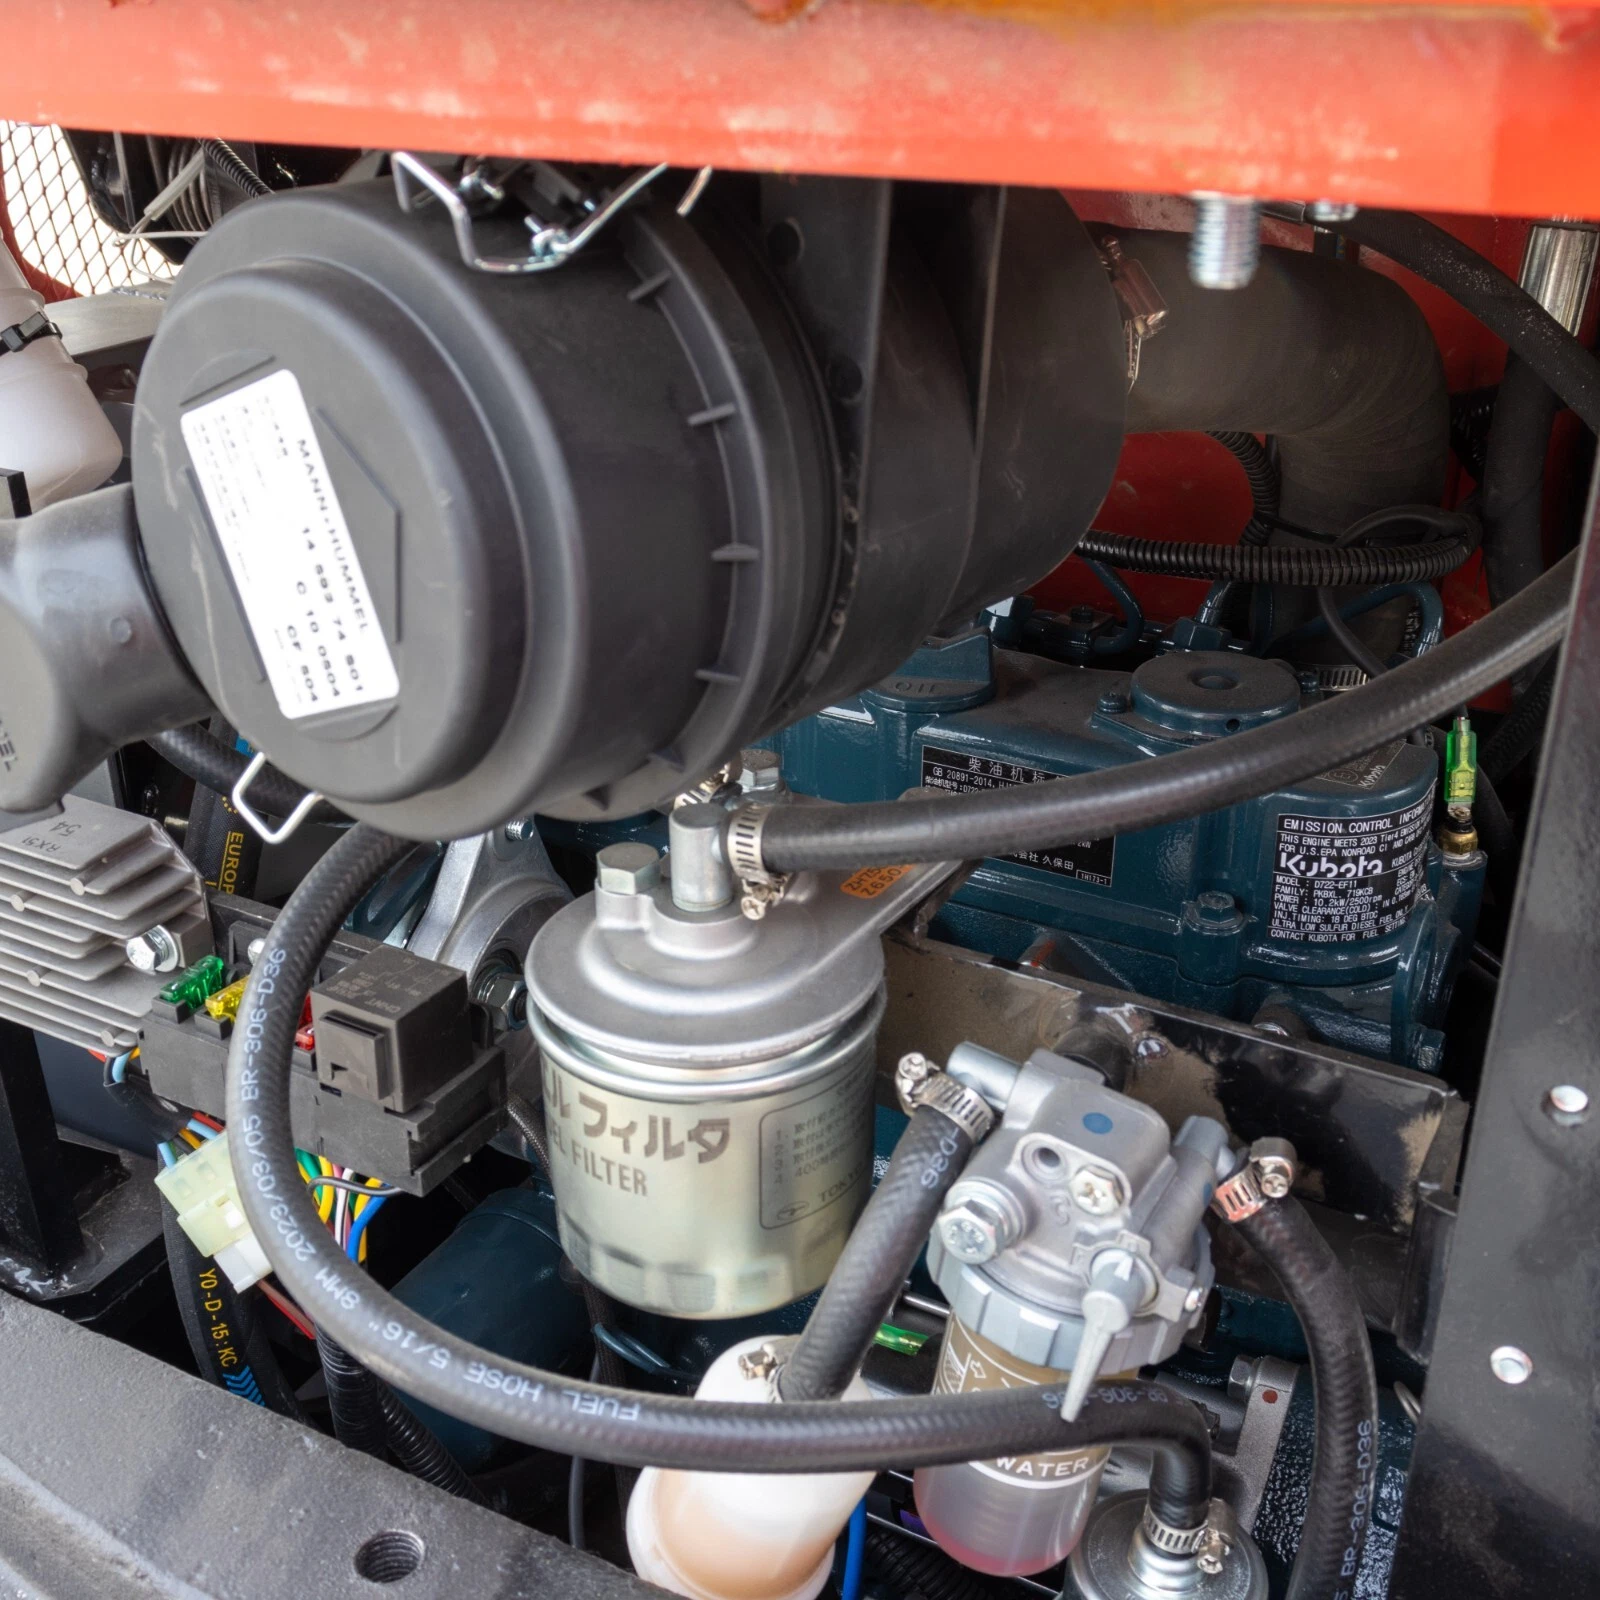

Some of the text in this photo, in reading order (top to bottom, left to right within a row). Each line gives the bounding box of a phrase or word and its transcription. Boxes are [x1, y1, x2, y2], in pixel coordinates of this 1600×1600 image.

[932, 766, 943, 777] GB
[1284, 818, 1343, 834] EMISSION
[1349, 817, 1393, 834] CONTROL
[1279, 842, 1296, 854] FOR
[1299, 846, 1338, 857] U.S.EPA
[1341, 845, 1376, 857] NONROAD
[1379, 843, 1388, 853] CI
[1392, 838, 1404, 850] AND
[1280, 833, 1299, 844] THIS
[1302, 836, 1331, 847] ENGINE
[1334, 838, 1358, 847] MEETS
[1360, 836, 1378, 846] 2023
[1280, 852, 1383, 878] Kubota
[1276, 875, 1357, 889] MODEL D722-EF11
[1274, 893, 1299, 904] POWER
[1274, 901, 1298, 913] VALVE
[1271, 918, 1297, 930] ULTRA
[1300, 922, 1316, 931] LOW
[1319, 923, 1348, 932] SULFUR
[1351, 919, 1376, 931] DIESEL
[1379, 913, 1393, 925] FUEL
[1331, 915, 1340, 924] 18
[1343, 914, 1358, 923] DEG
[1360, 910, 1379, 920] BTDC
[1270, 929, 1305, 941] CONTACT
[1308, 933, 1338, 943] KUBOTA
[1341, 933, 1356, 942] FOR
[1362, 929, 1379, 940] FUEL
[241, 948, 287, 1101] BR-306-D36
[571, 1138, 649, 1197] FILTER
[242, 1114, 317, 1262] 2023/03/05
[315, 1266, 361, 1310] 8MM
[463, 1362, 545, 1402] HOSE
[563, 1389, 641, 1421] FUEL
[996, 1456, 1090, 1477] WATER
[1341, 1419, 1372, 1576] BR-306-D36
